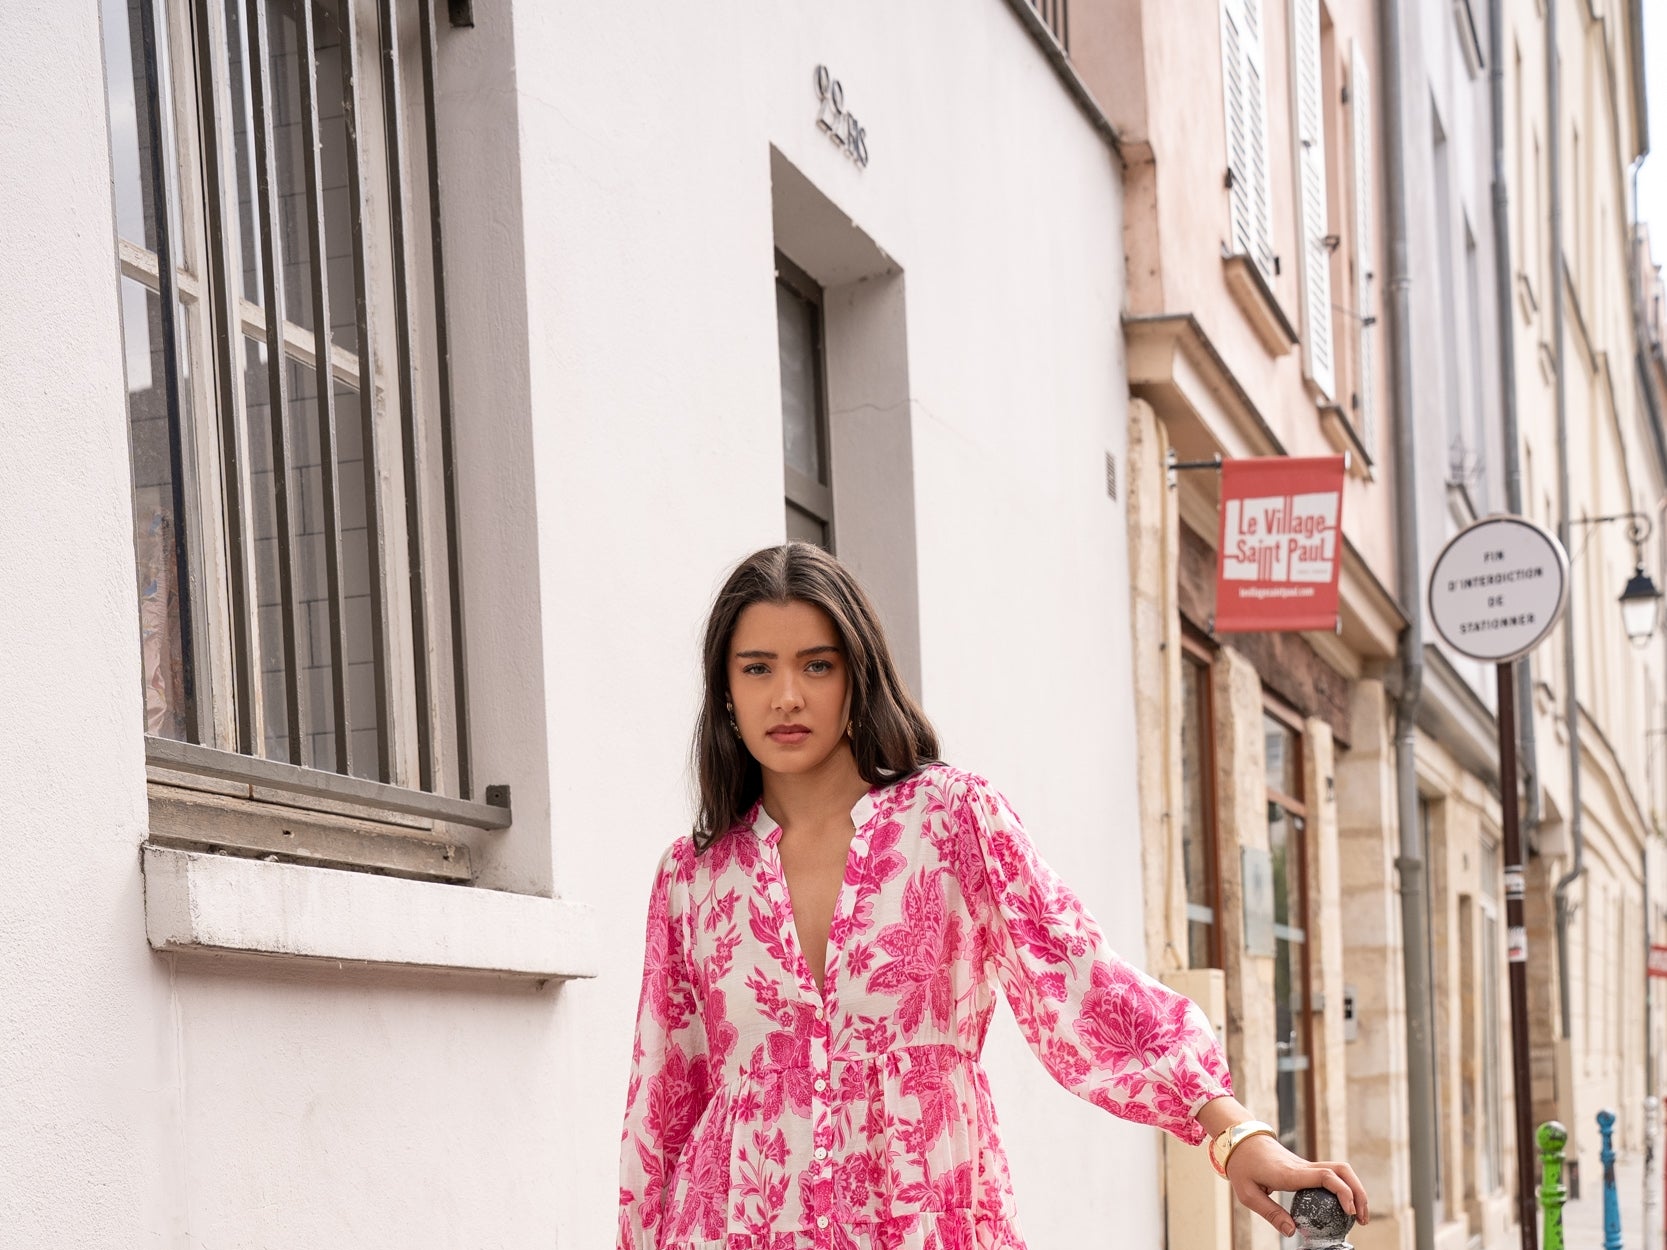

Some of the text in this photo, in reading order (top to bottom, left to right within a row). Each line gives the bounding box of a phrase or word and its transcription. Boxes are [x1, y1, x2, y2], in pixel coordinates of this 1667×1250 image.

[1238, 498, 1327, 539] Le Village
[1236, 537, 1327, 577] Saint Paul
[1483, 550, 1504, 562] FIN
[1447, 567, 1543, 592] D'INTERDICTION
[1487, 595, 1504, 608] DE
[1459, 613, 1535, 634] STATIONNER
